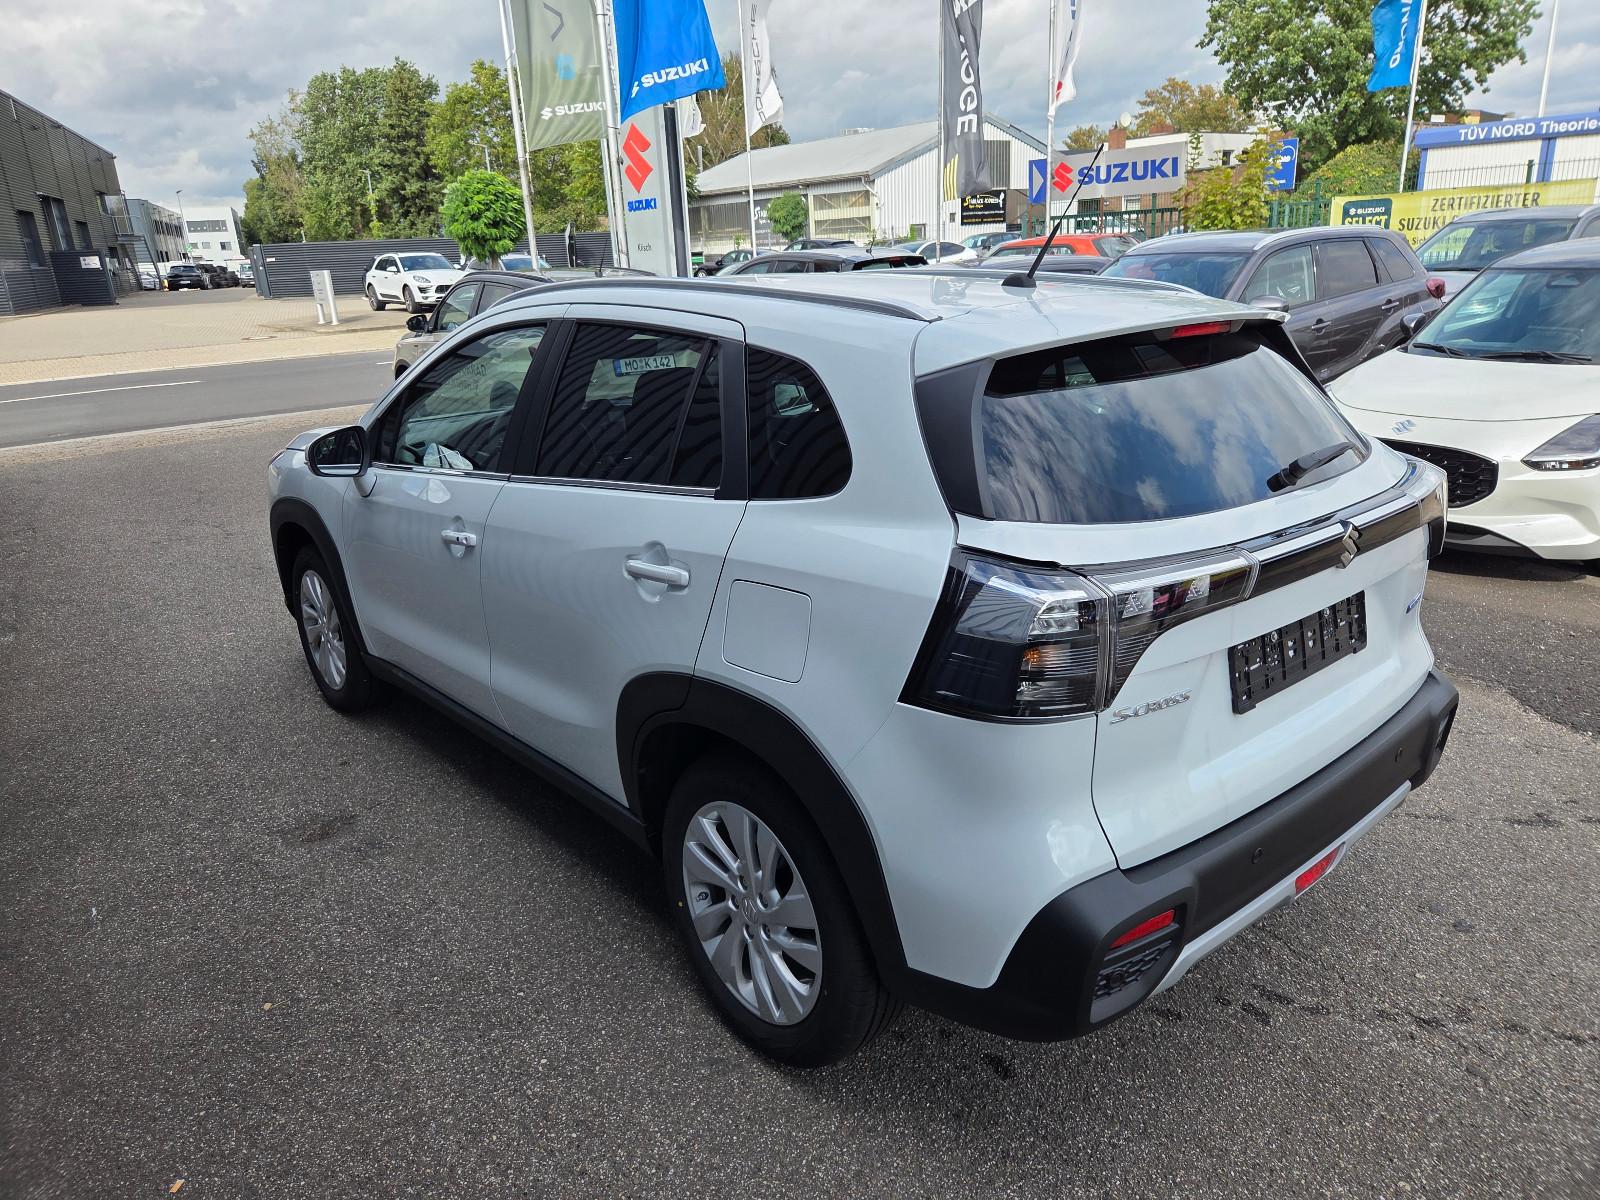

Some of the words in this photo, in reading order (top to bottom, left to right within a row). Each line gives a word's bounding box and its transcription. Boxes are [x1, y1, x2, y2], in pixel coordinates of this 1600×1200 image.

[641, 57, 709, 88] SUZUKI
[555, 101, 607, 116] SUZUKI
[1459, 126, 1488, 141] TÜV
[1491, 122, 1535, 139] NORD
[1077, 156, 1179, 186] SUZUKI
[627, 197, 657, 212] SUZUKI
[1357, 206, 1385, 215] SUZUKI
[1431, 192, 1541, 212] ZERTIFIZIERTER
[1398, 215, 1447, 232] SUZUKI
[624, 359, 639, 371] MO
[643, 358, 652, 369] K
[652, 356, 672, 369] 142
